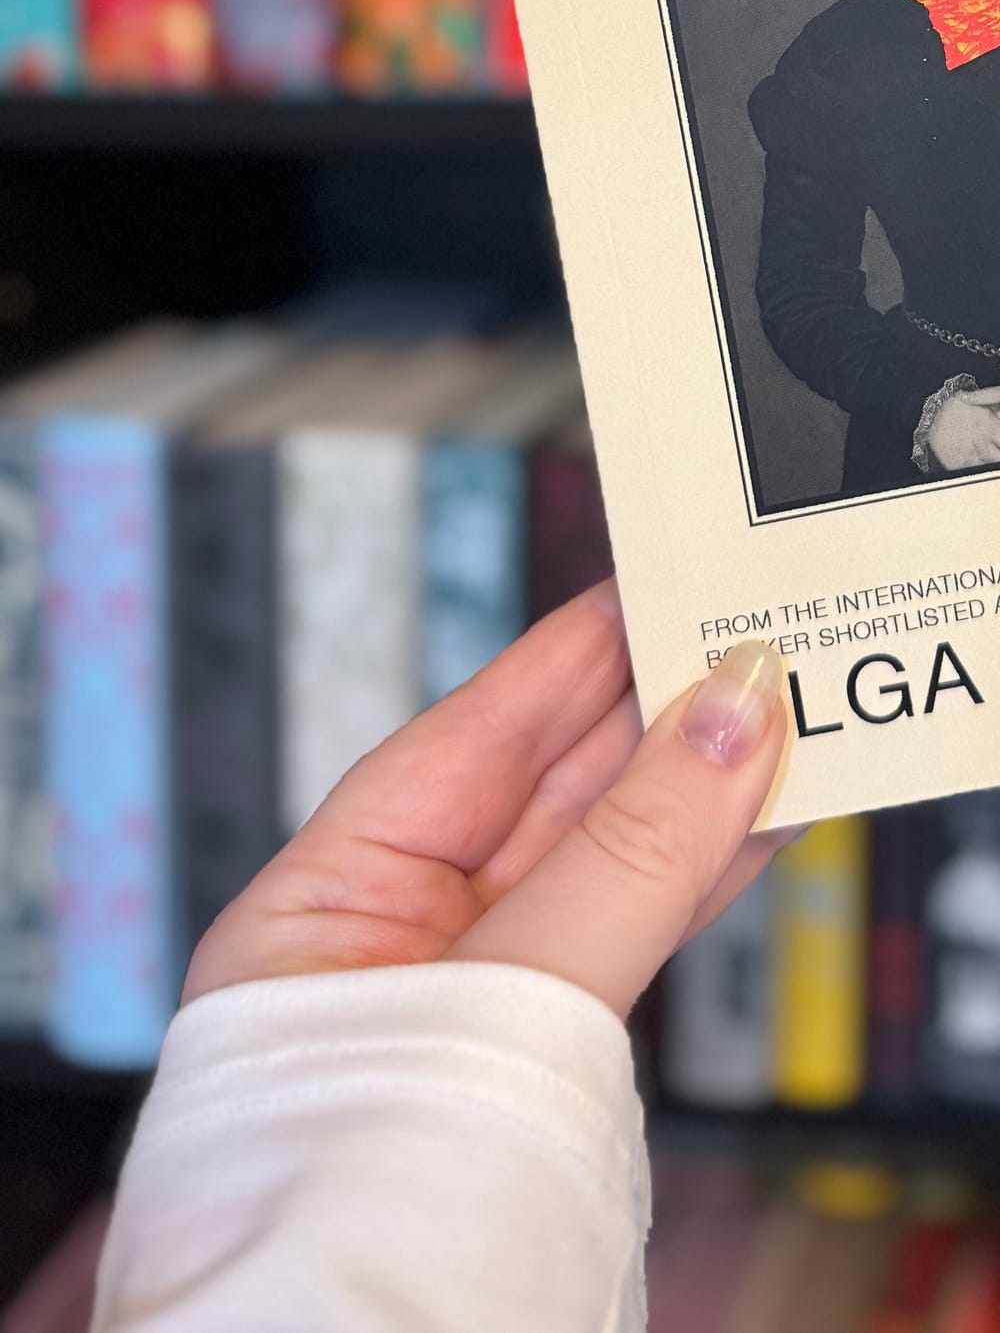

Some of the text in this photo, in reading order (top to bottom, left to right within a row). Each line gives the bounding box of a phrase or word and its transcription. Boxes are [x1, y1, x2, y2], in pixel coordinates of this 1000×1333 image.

[701, 610, 772, 641] FROM
[779, 598, 828, 625] THE
[819, 598, 985, 647] SHORTLISTED
